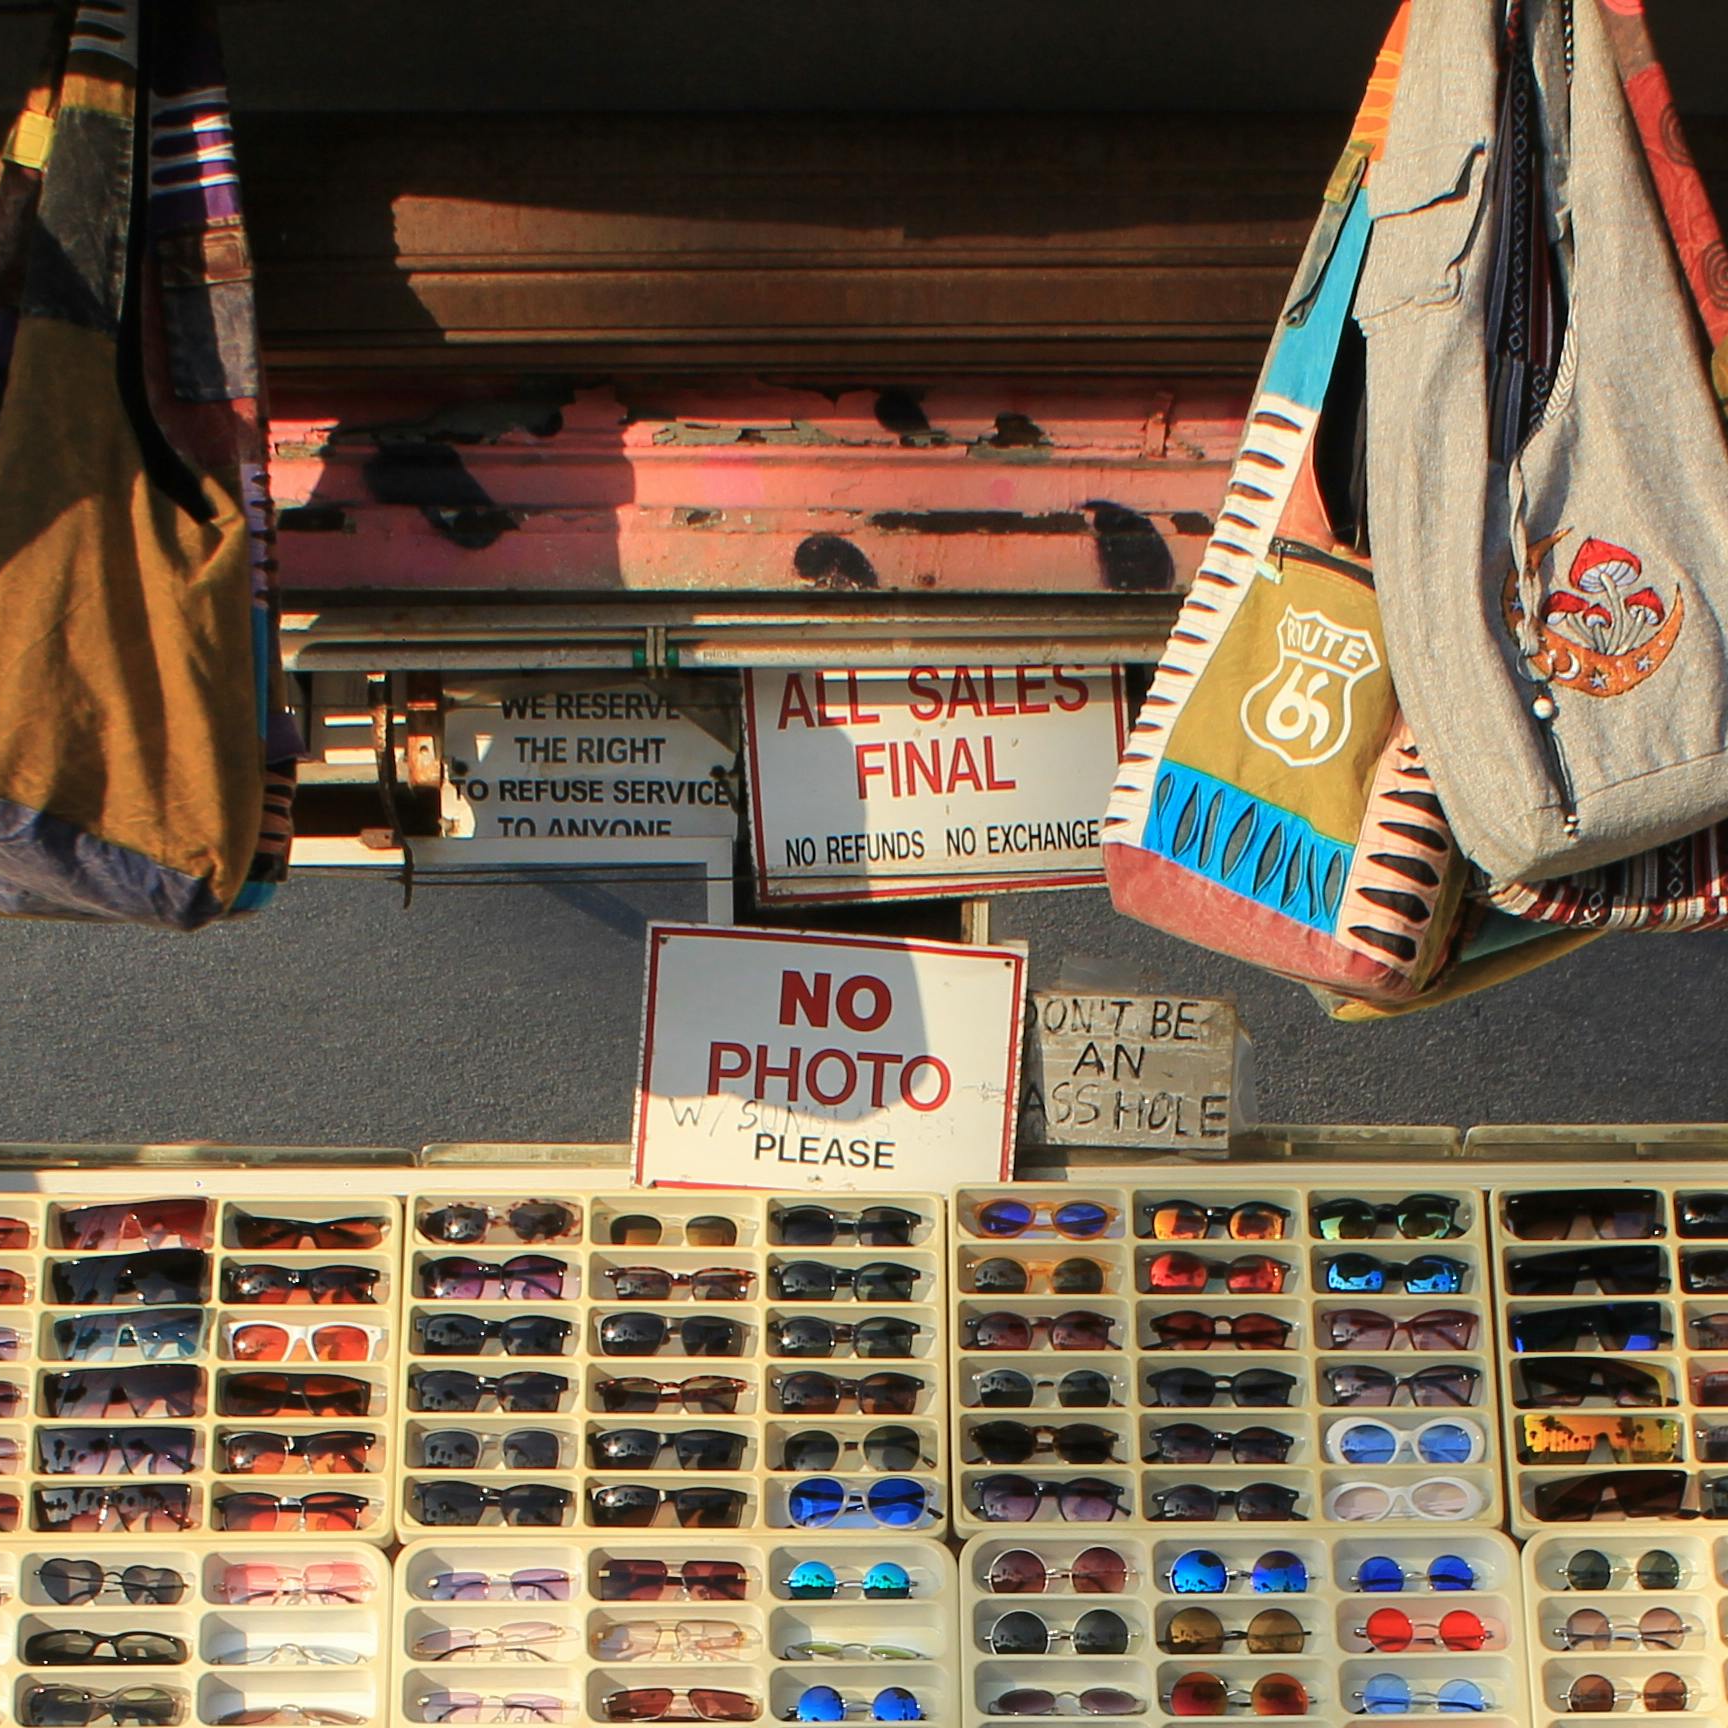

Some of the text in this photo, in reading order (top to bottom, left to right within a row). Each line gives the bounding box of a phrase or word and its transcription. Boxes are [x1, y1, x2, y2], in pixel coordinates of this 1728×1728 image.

[500, 696, 547, 721] WE
[777, 663, 1090, 731] ALL SALES
[1265, 661, 1331, 751] 66
[513, 736, 667, 765] THE RIGHT
[853, 734, 1017, 801] FINAL
[453, 778, 732, 807] TO REFUSE SERVICE
[497, 816, 673, 837] TO ANYONE
[785, 818, 1101, 868] NO REFUNDS NO EXCHANGE
[778, 968, 893, 1033] NO
[1150, 999, 1200, 1041] BE
[706, 1041, 952, 1113] PHOTO
[1072, 1041, 1146, 1081] AN
[753, 1132, 897, 1170] PLEASE
